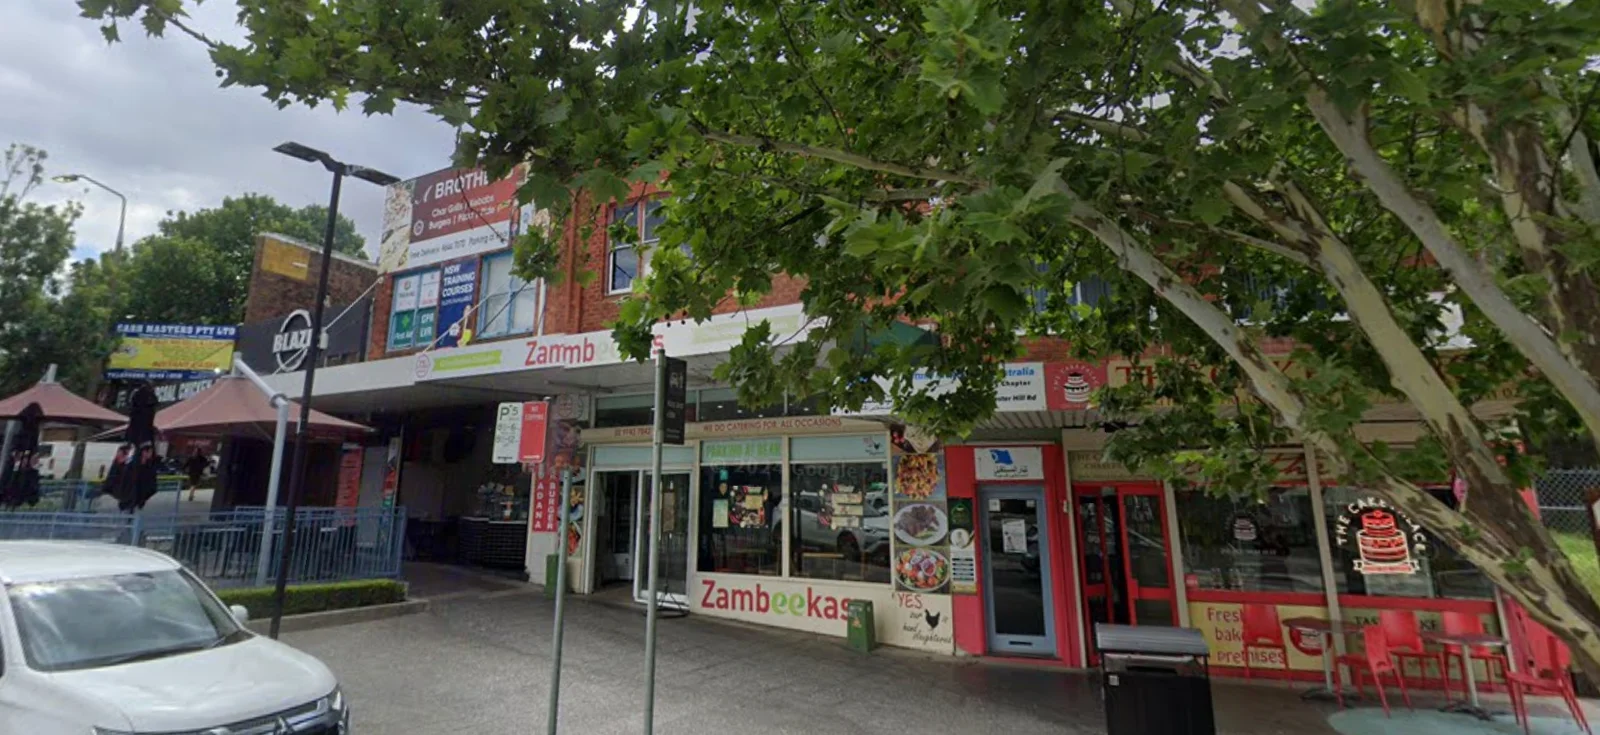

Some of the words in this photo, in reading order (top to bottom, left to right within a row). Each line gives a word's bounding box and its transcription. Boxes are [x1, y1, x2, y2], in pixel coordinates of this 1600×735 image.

[444, 263, 462, 274] NSW
[443, 271, 476, 286] TRAINING
[442, 283, 474, 298] COURSES
[145, 324, 194, 335] MASTERS
[195, 326, 215, 336] PTY
[216, 326, 236, 336] LTD
[500, 406, 510, 420] P
[714, 424, 725, 432] DO
[727, 421, 761, 431] CATERING
[762, 420, 777, 430] FOR
[781, 419, 794, 428] ALL
[795, 417, 841, 428] OCCASIONS
[534, 481, 543, 529] ADANA
[547, 481, 556, 529] BURGER
[1336, 514, 1351, 545] THE
